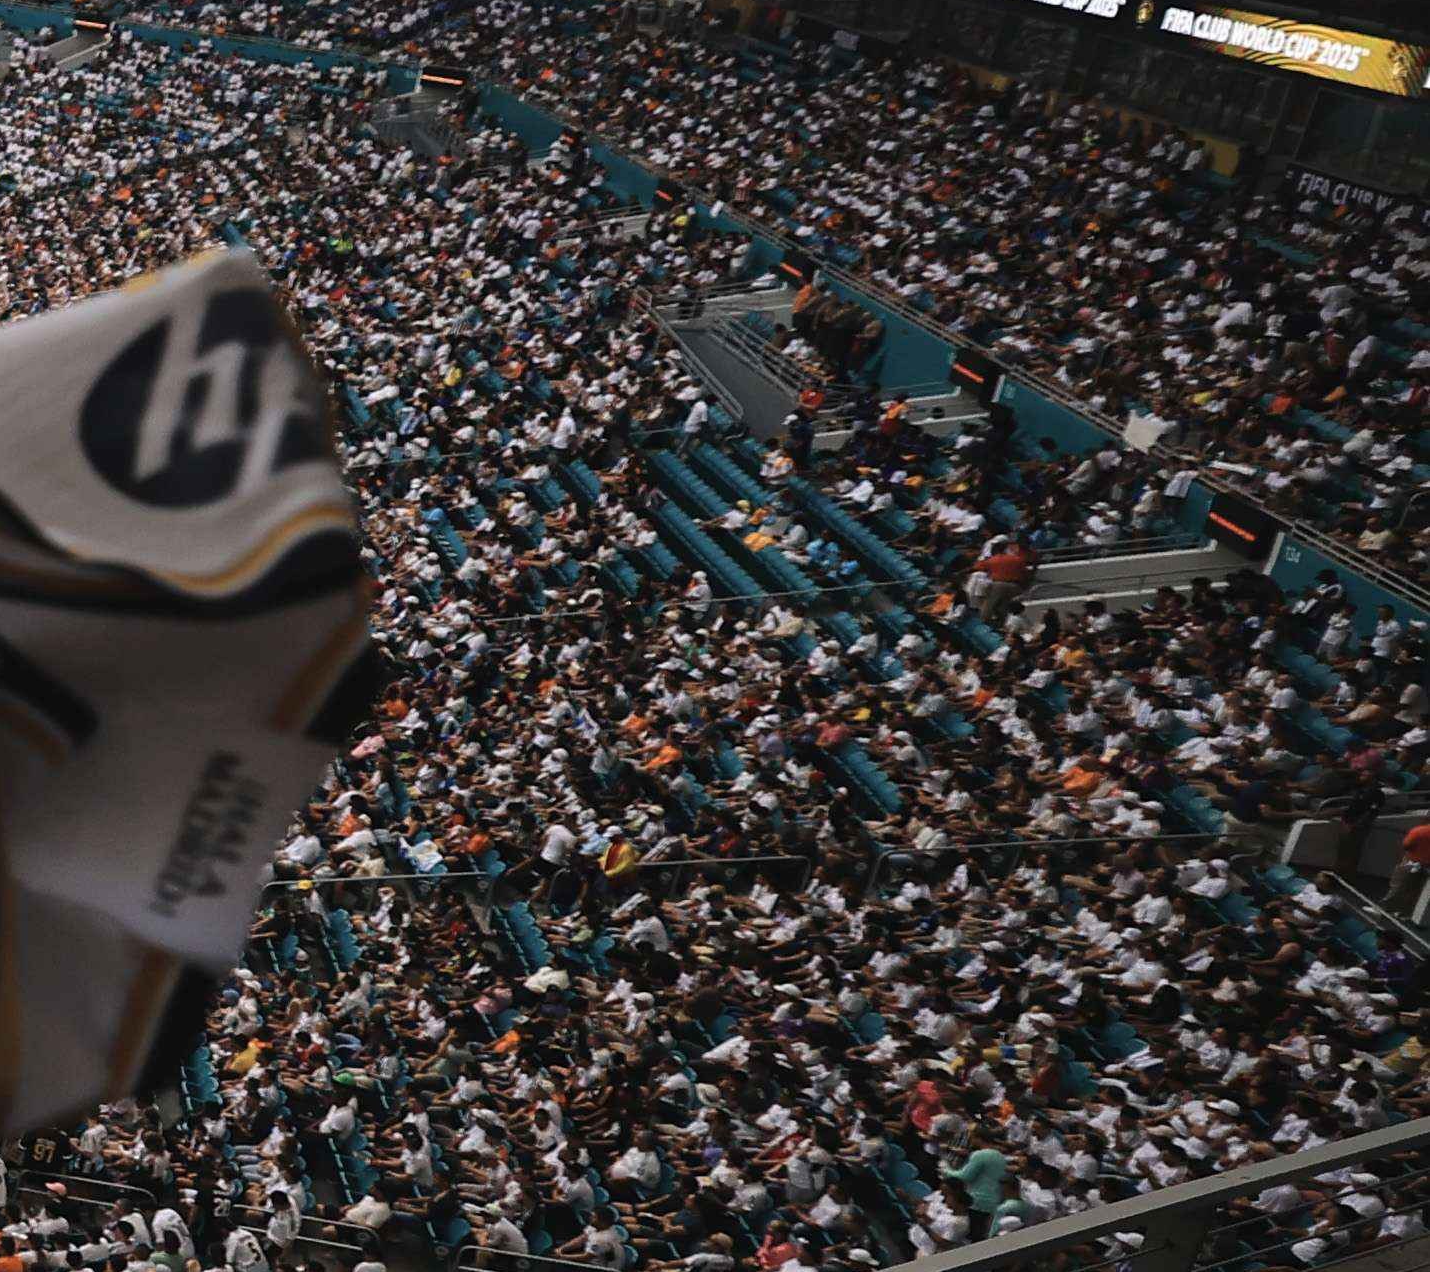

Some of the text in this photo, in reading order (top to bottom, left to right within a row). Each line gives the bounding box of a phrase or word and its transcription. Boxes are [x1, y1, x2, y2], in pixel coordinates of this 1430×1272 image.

[1160, 7, 1195, 35] FIFA
[1191, 13, 1231, 43] CLUB
[1227, 20, 1285, 53] WORLD
[1283, 31, 1321, 59] CUP
